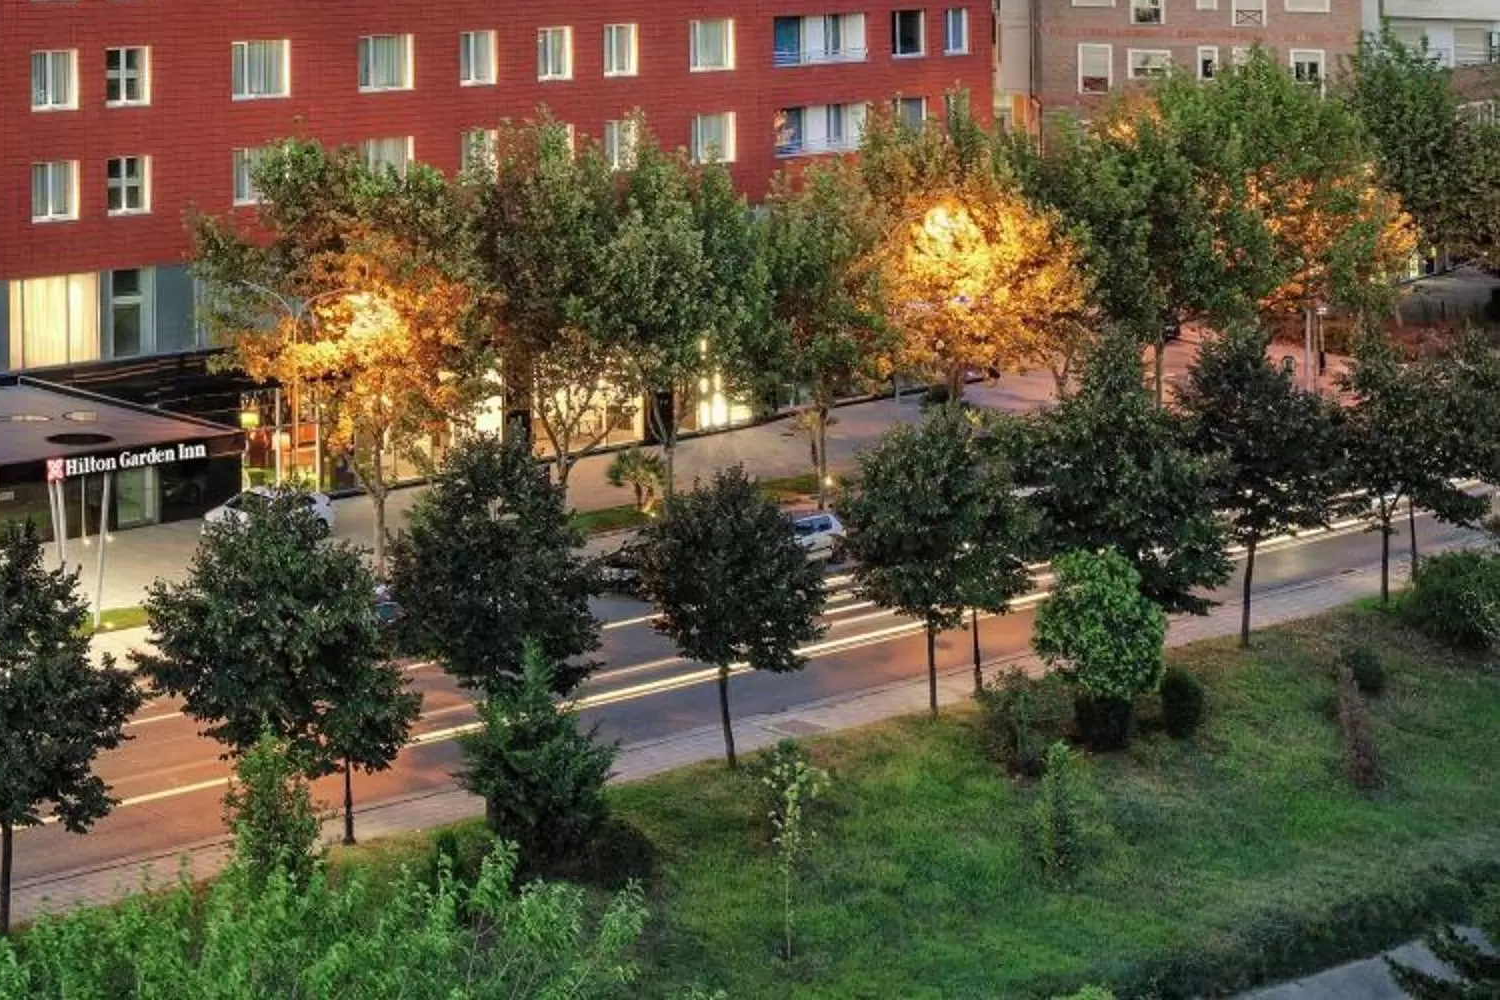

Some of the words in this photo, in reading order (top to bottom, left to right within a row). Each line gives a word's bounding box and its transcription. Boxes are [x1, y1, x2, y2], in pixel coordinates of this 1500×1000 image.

[65, 456, 117, 476] Hilton
[119, 447, 175, 468] Garden
[177, 443, 206, 460] Inn
